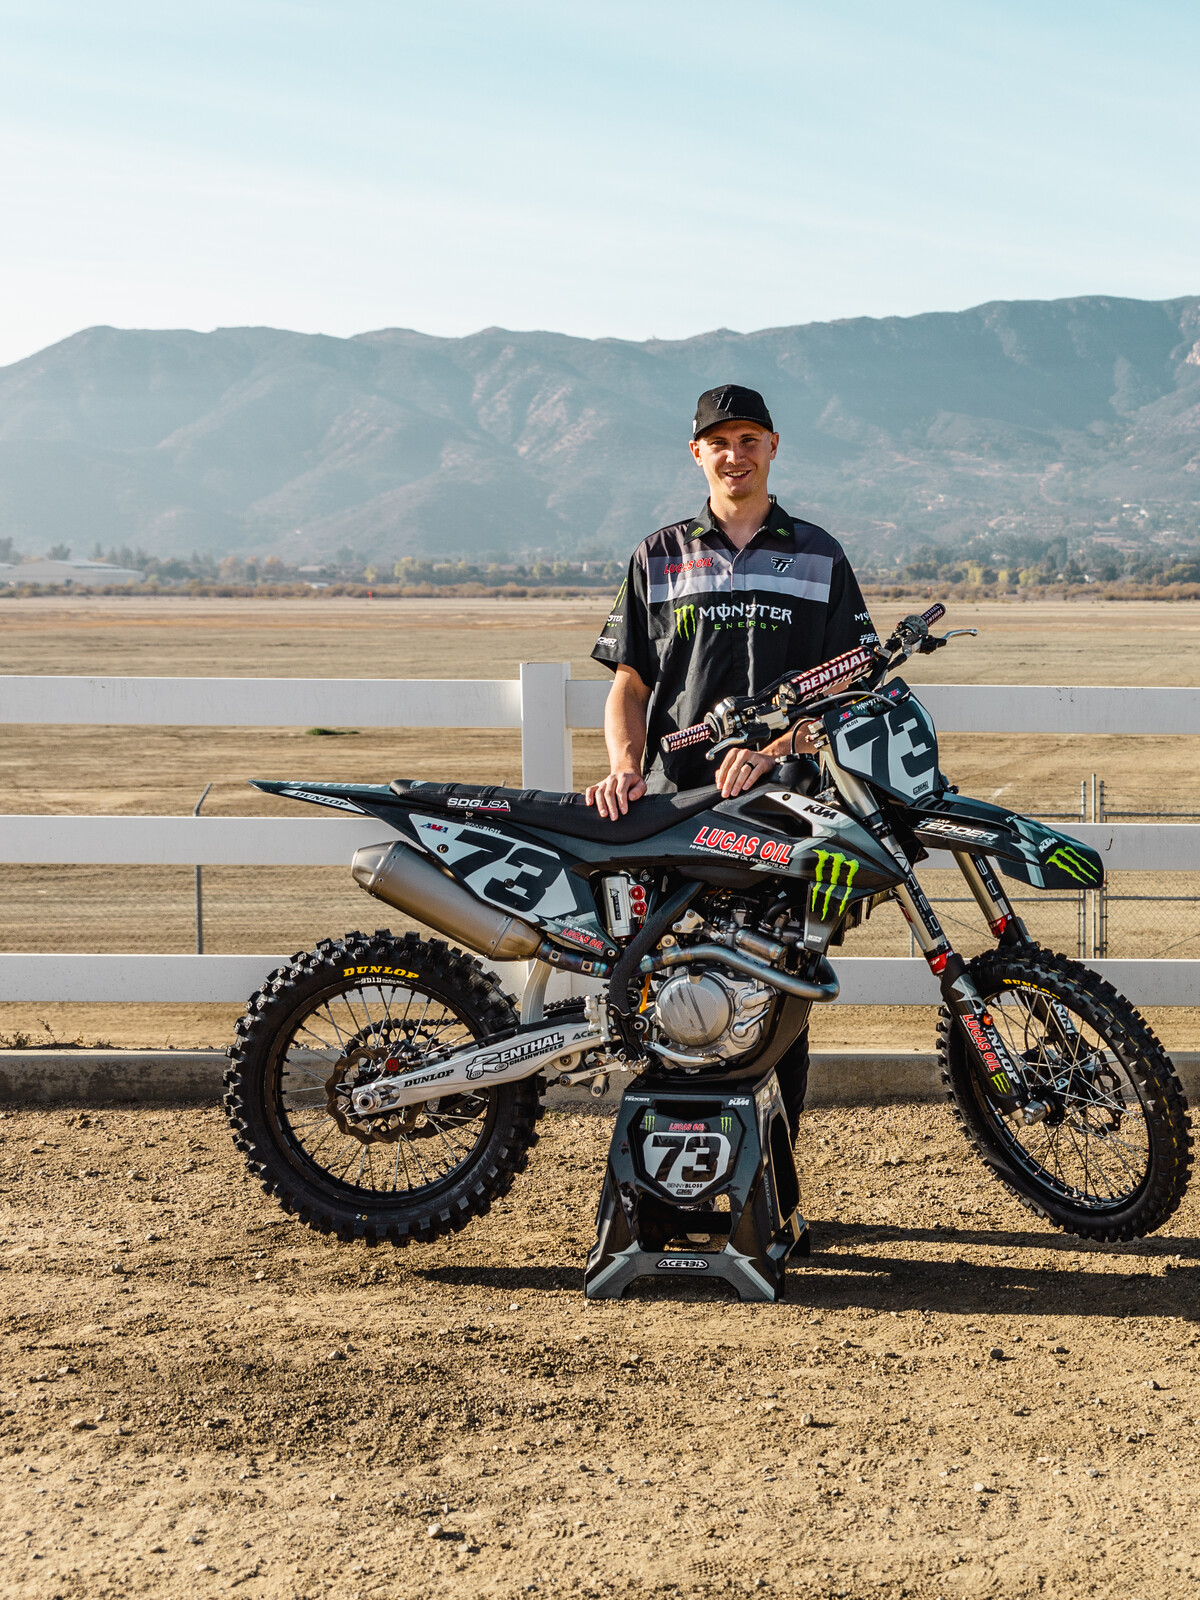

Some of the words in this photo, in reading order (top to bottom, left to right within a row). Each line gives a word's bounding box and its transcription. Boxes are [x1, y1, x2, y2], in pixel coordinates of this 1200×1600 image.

[664, 560, 694, 574] LUCAS
[696, 558, 714, 569] OIL
[699, 602, 792, 624] MONSTER
[714, 620, 778, 631] ENERGY
[799, 650, 871, 694] RENTHAL
[670, 730, 710, 748] RENTHAL
[844, 700, 935, 778] 73
[295, 792, 348, 806] DUNLOP
[803, 804, 839, 820] KTM
[916, 820, 999, 841] TEDDER
[693, 825, 760, 856] LUCAS
[760, 840, 792, 865] OIL
[1038, 836, 1058, 853] KTM
[689, 844, 740, 859] HI-PERFORMANCE
[749, 857, 779, 868] PRODUCTS
[450, 829, 563, 912] 73
[562, 928, 590, 944] LUCAS
[589, 938, 604, 950] OIL
[343, 966, 420, 979] DUNLOP
[963, 1014, 992, 1050] LUCAS
[983, 1052, 1001, 1072] OIL
[509, 1044, 564, 1066] CHAINWHEELS
[403, 1068, 455, 1087] DUNLOP
[728, 1098, 749, 1106] KTM
[669, 1123, 692, 1131] LUCAS
[692, 1123, 705, 1131] OIL
[652, 1135, 721, 1183] 73
[660, 1260, 706, 1268] ACERBIS
